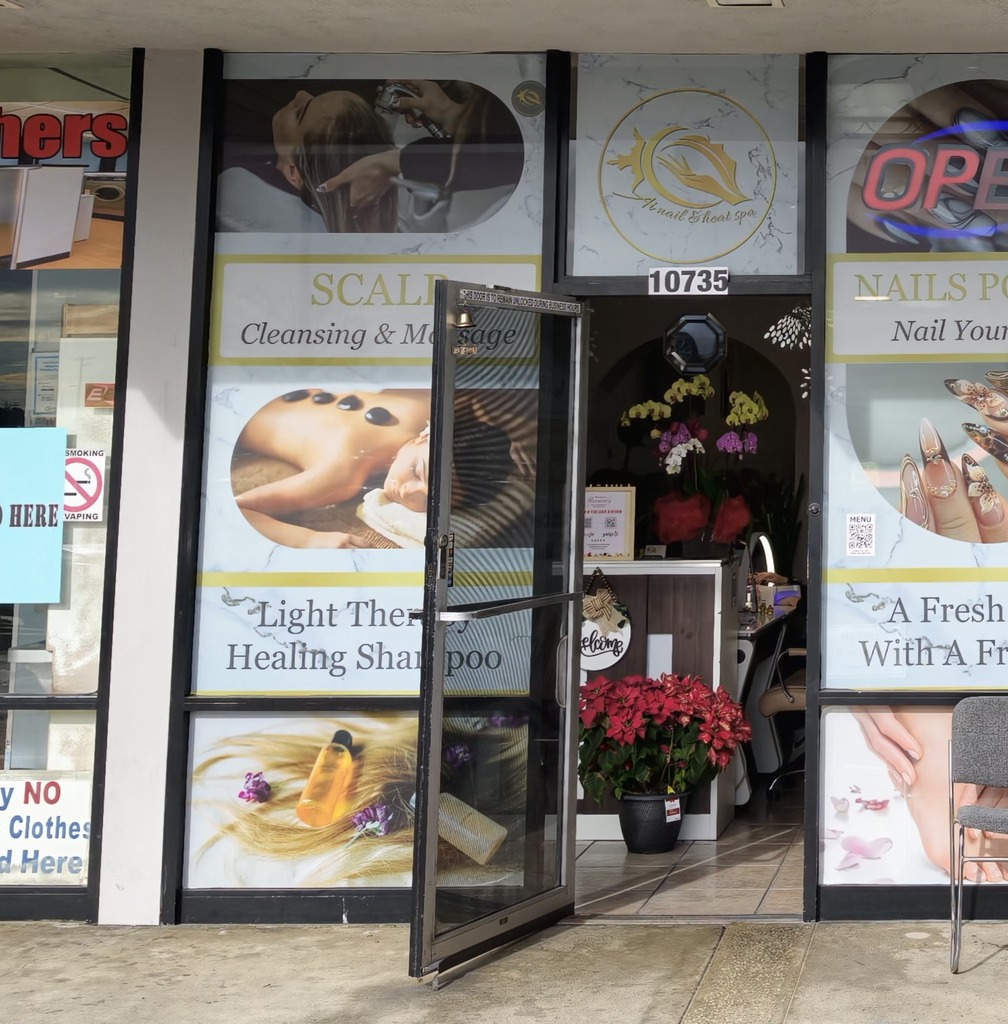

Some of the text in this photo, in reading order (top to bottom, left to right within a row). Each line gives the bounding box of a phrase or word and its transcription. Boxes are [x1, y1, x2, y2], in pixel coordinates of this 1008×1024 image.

[657, 207, 688, 222] nail
[735, 208, 758, 226] spa
[650, 269, 728, 293] 10735
[854, 273, 968, 302] NAILS
[240, 322, 516, 351] Cleansing & Msage
[891, 319, 946, 342] Nail
[65, 449, 104, 457] SMOKING
[9, 504, 58, 528] HERE
[258, 600, 338, 634] Light
[887, 596, 912, 623] A
[920, 594, 1005, 623] Fresh
[580, 630, 623, 657] elcome
[859, 637, 933, 667] With
[946, 639, 967, 666] A
[226, 642, 502, 677] Healing Shapoo
[23, 781, 61, 804] NO
[9, 815, 91, 839] Clothes
[20, 850, 83, 874] Here
